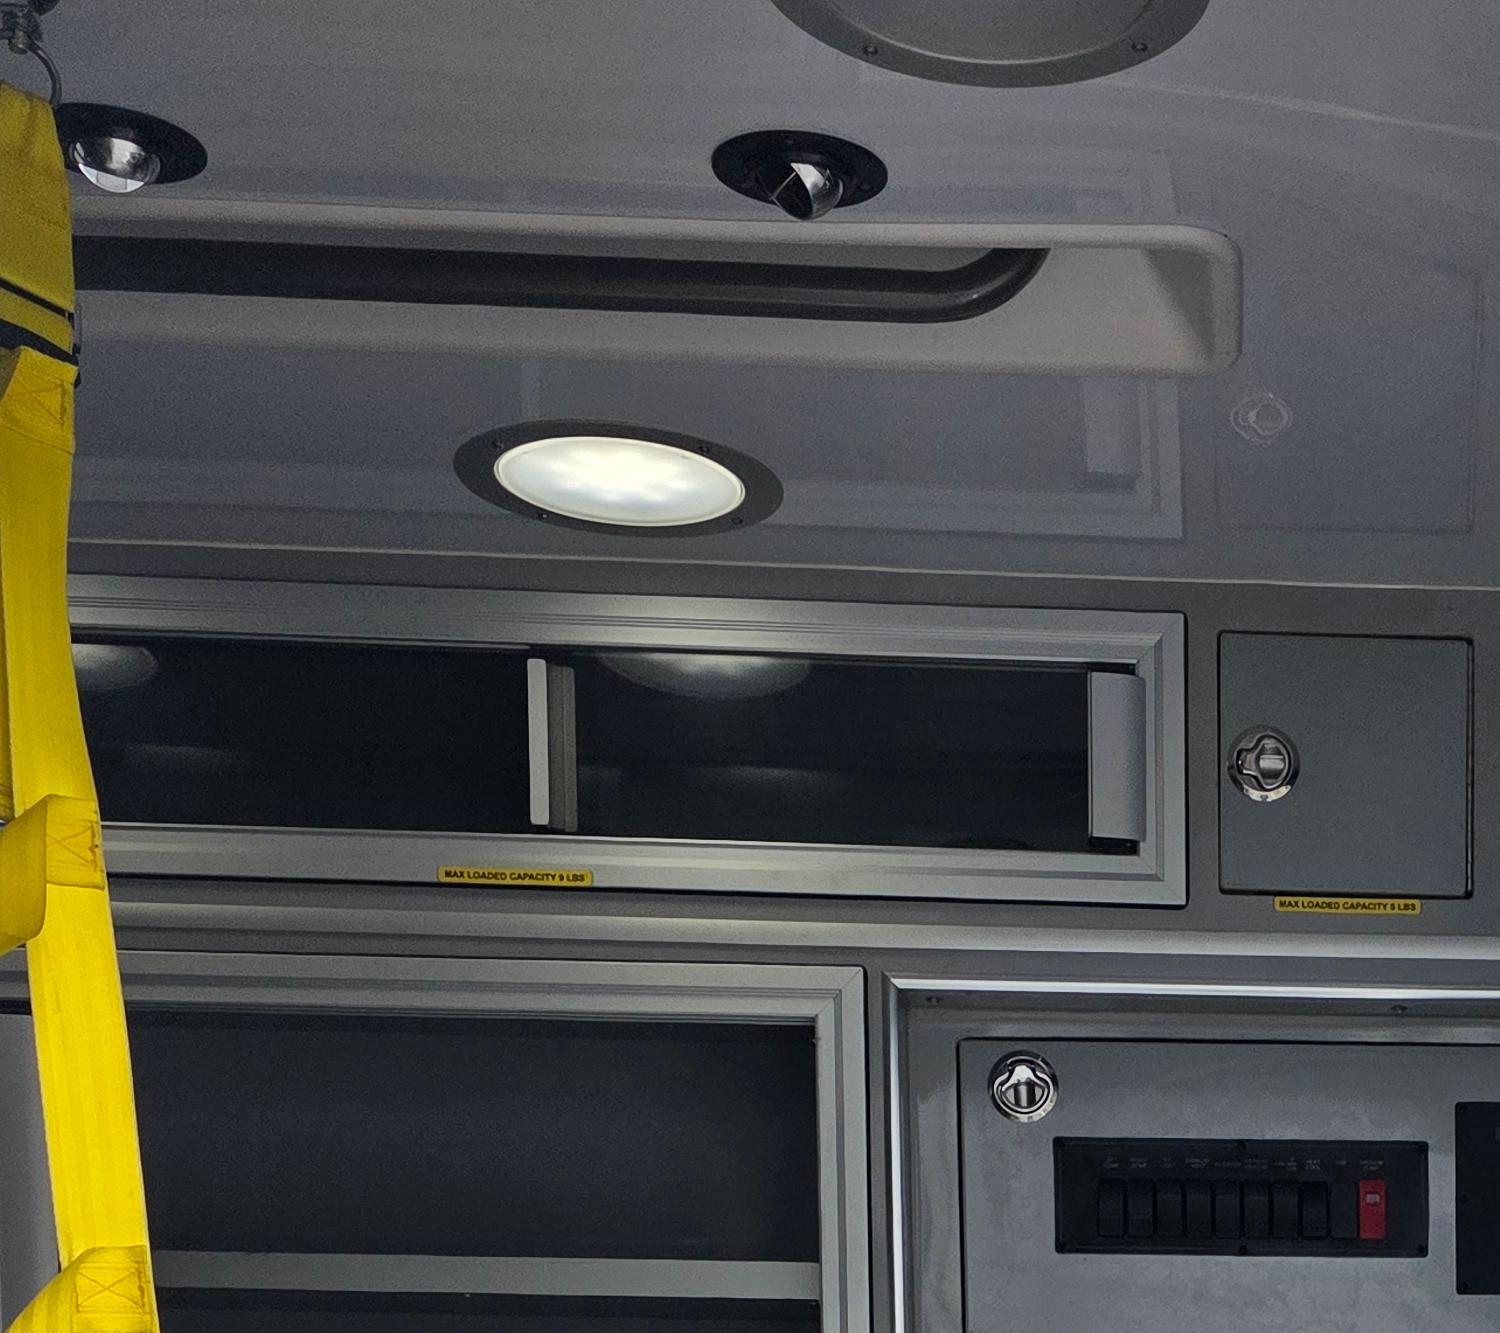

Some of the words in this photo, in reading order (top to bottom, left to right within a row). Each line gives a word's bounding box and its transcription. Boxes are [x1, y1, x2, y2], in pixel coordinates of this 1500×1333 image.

[444, 870, 465, 879] MAX
[467, 871, 507, 881] LOADED
[509, 872, 556, 882] CAPACITY
[566, 873, 586, 882] LBS
[1279, 900, 1300, 909] MAX
[1301, 901, 1340, 910] LOADED
[1342, 902, 1388, 911] CAPACITY
[1397, 903, 1417, 912] LBS
